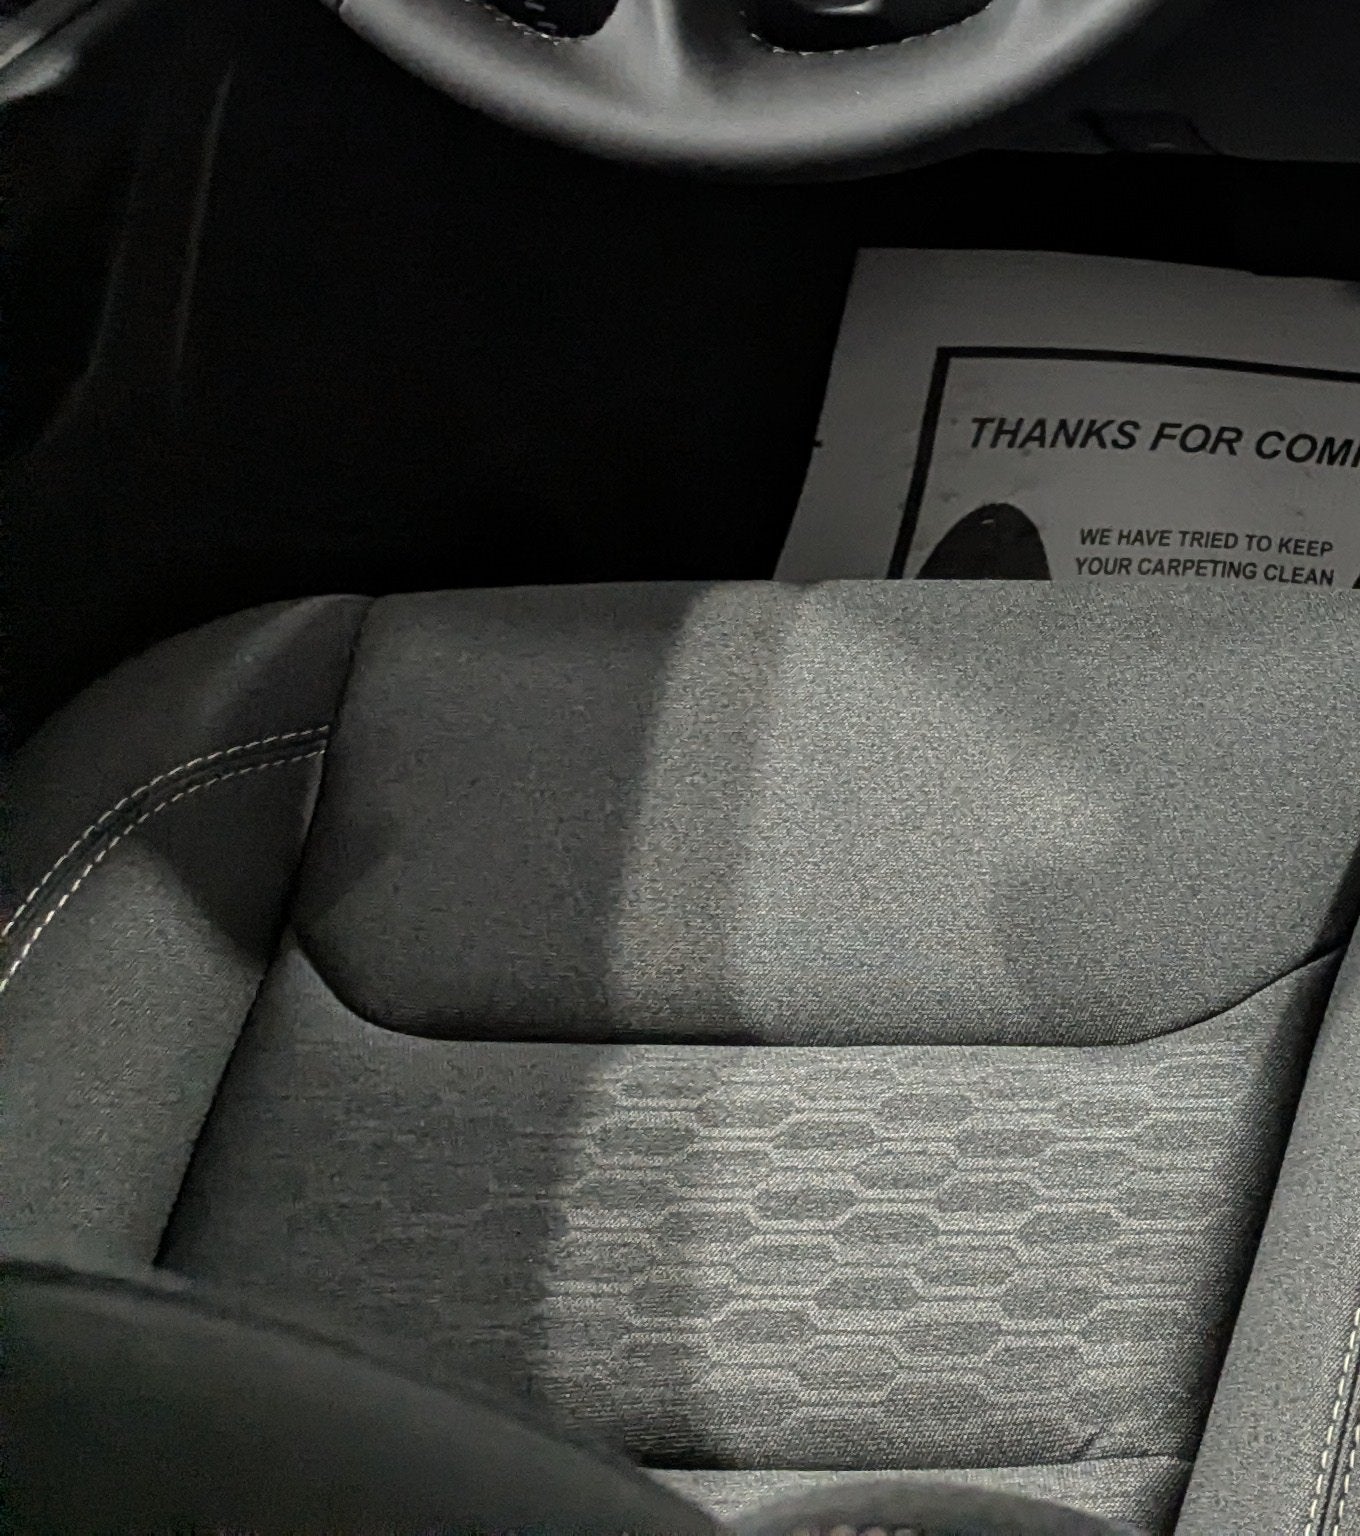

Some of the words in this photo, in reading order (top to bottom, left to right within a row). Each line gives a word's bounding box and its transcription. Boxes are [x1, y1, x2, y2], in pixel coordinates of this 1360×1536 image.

[970, 418, 1140, 450] THANKS
[1150, 423, 1242, 456] FOR
[1080, 528, 1112, 546] WE
[1117, 528, 1172, 547] HAVE
[1178, 530, 1239, 549] TRIED
[1245, 534, 1273, 552] TO
[1278, 537, 1334, 557] KEEP
[1076, 556, 1133, 576] YOUR
[1137, 557, 1257, 581] CARPETING
[1264, 564, 1335, 587] CLEAN
